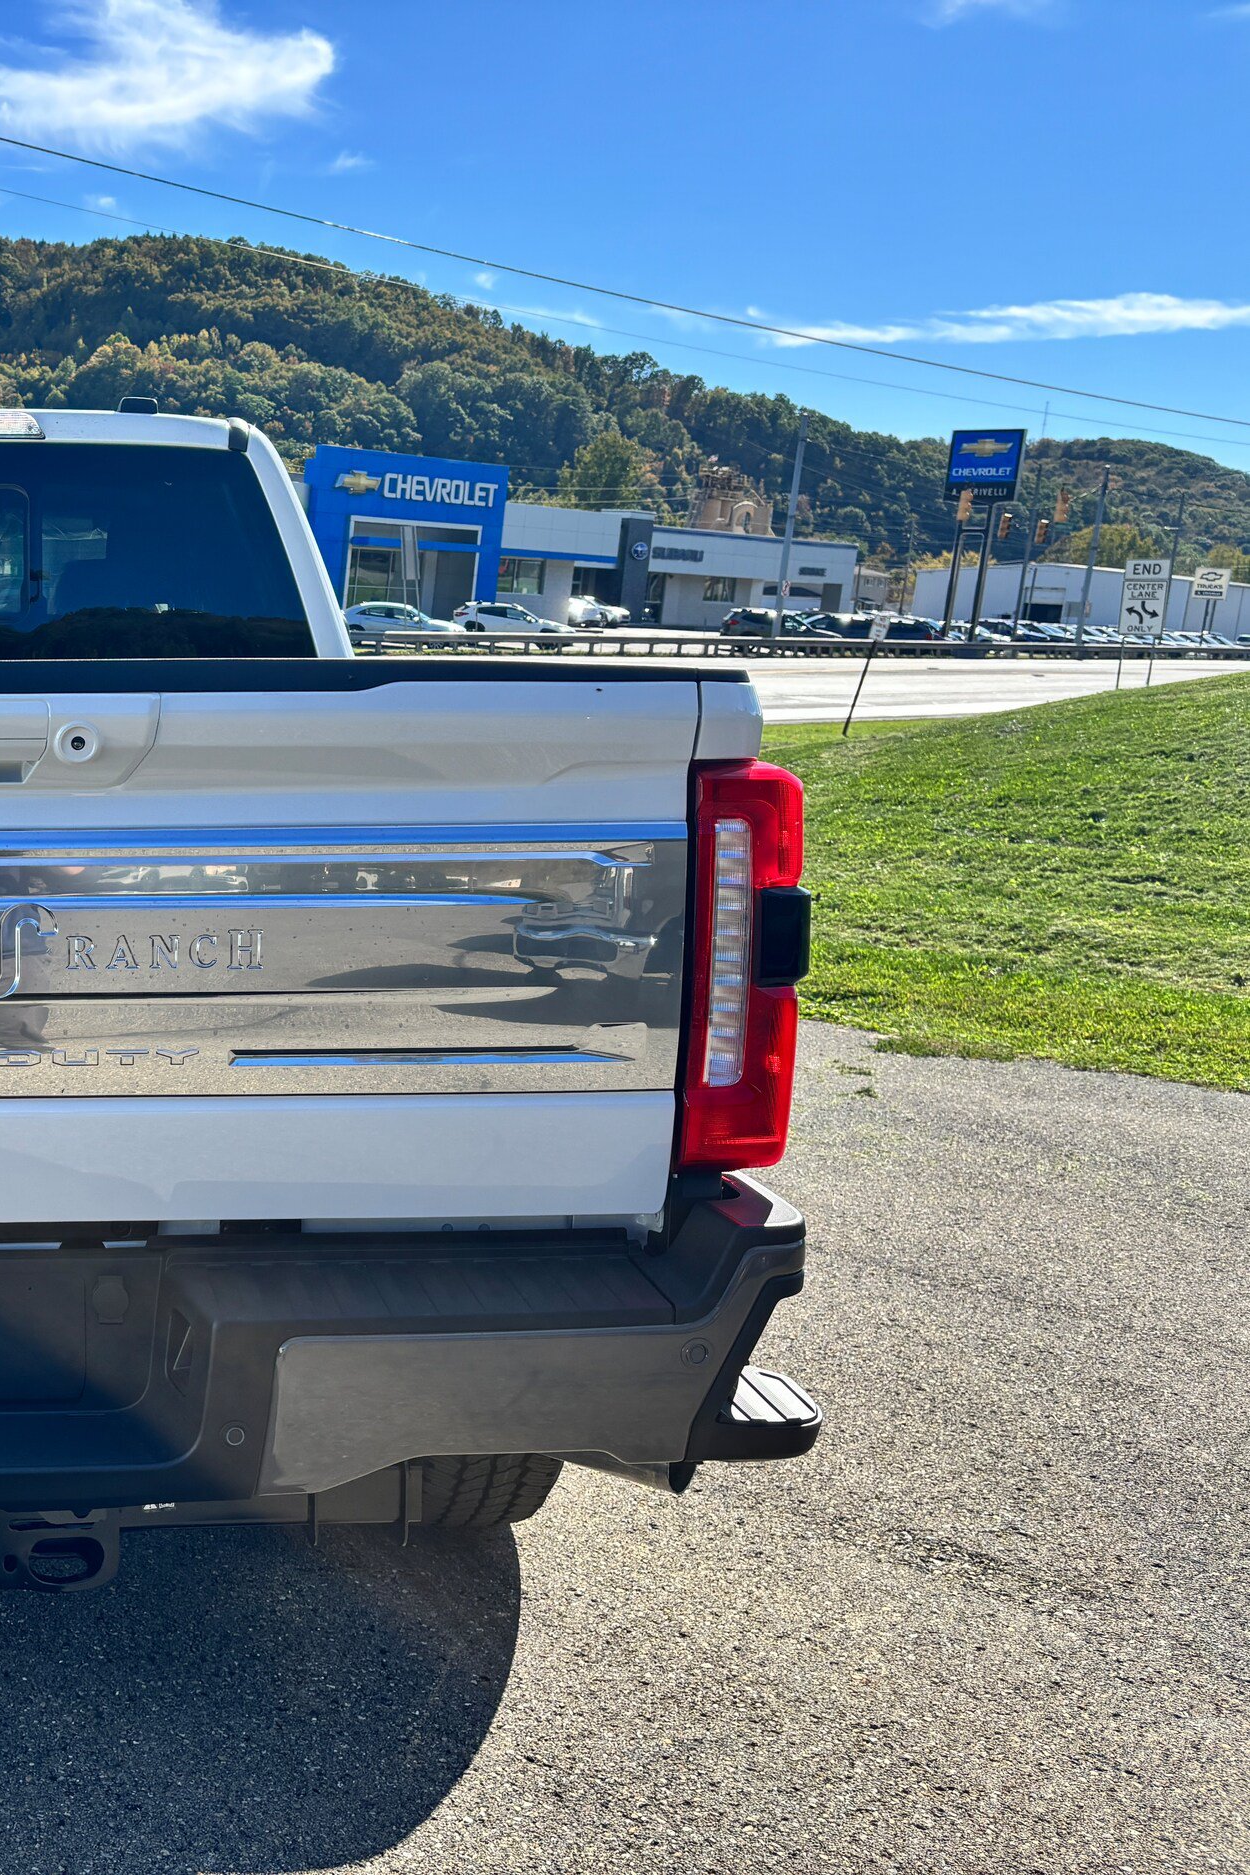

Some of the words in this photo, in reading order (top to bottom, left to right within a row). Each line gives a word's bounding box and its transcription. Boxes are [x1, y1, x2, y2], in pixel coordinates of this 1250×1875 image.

[952, 467, 1012, 476] CHEVROLET
[383, 472, 498, 508] CHEVROLET
[1132, 563, 1162, 576] END
[1126, 582, 1164, 591] CENTER
[1131, 591, 1158, 599] LANE
[1127, 625, 1154, 633] ONLY
[66, 928, 265, 970] RANCH
